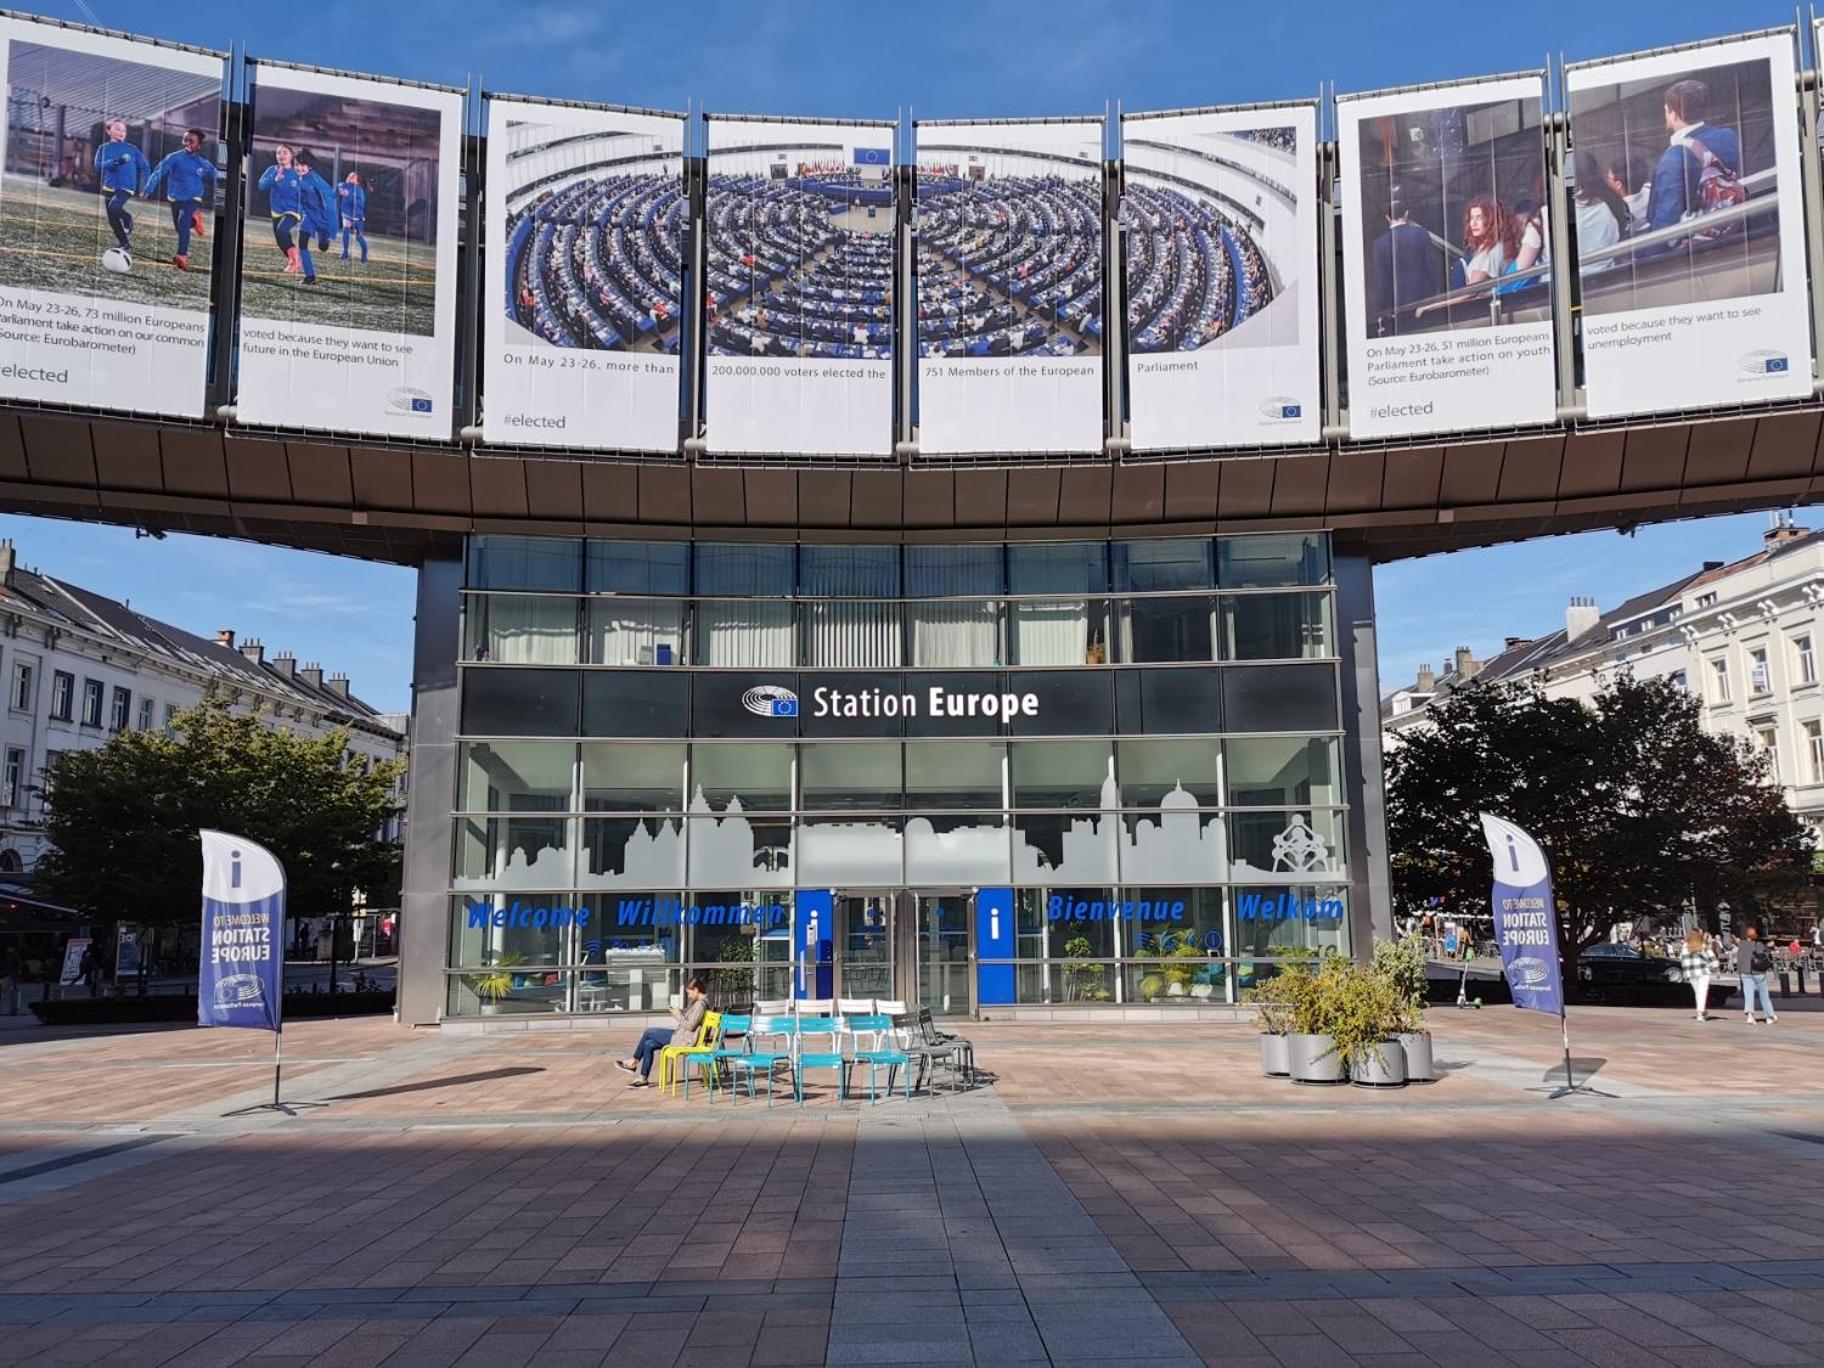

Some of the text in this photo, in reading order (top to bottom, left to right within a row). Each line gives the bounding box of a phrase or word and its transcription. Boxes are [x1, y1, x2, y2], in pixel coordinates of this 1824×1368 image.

[17, 299, 41, 313] May
[46, 302, 81, 318] 23-26,
[85, 308, 99, 320] 73
[102, 311, 141, 325] million
[145, 315, 205, 333] Europeans
[1586, 306, 1761, 336] voted because they want to see
[0, 313, 204, 348] arliament take action on our common
[243, 330, 413, 354] voted because they want to see
[1588, 332, 1672, 350] unemployment
[44, 333, 136, 355] Eurobarometer)
[243, 342, 399, 367] future in the European Union
[1366, 348, 1382, 358] On
[1385, 345, 1406, 357] May
[1442, 340, 1453, 351] 51
[1457, 338, 1492, 349] million
[1494, 333, 1549, 345] Europeans
[504, 353, 674, 373] On May 23-26, more than
[1137, 361, 1199, 373] Parliament
[1367, 346, 1550, 371] Parliament take action on youth
[0, 363, 68, 383] elected
[784, 368, 818, 377] voters
[822, 366, 864, 378] elected
[867, 369, 886, 379] the
[925, 365, 1094, 378] 751 Members of the European
[1409, 366, 1489, 383] Eurobarometer)
[504, 413, 567, 429] #elected
[1371, 400, 1433, 418] #elected
[813, 686, 1040, 724] Station Europe
[468, 900, 591, 929] Welcome
[617, 898, 784, 926] Willkommen
[1048, 895, 1185, 921] Bienvenue
[1237, 893, 1343, 920] Welkom
